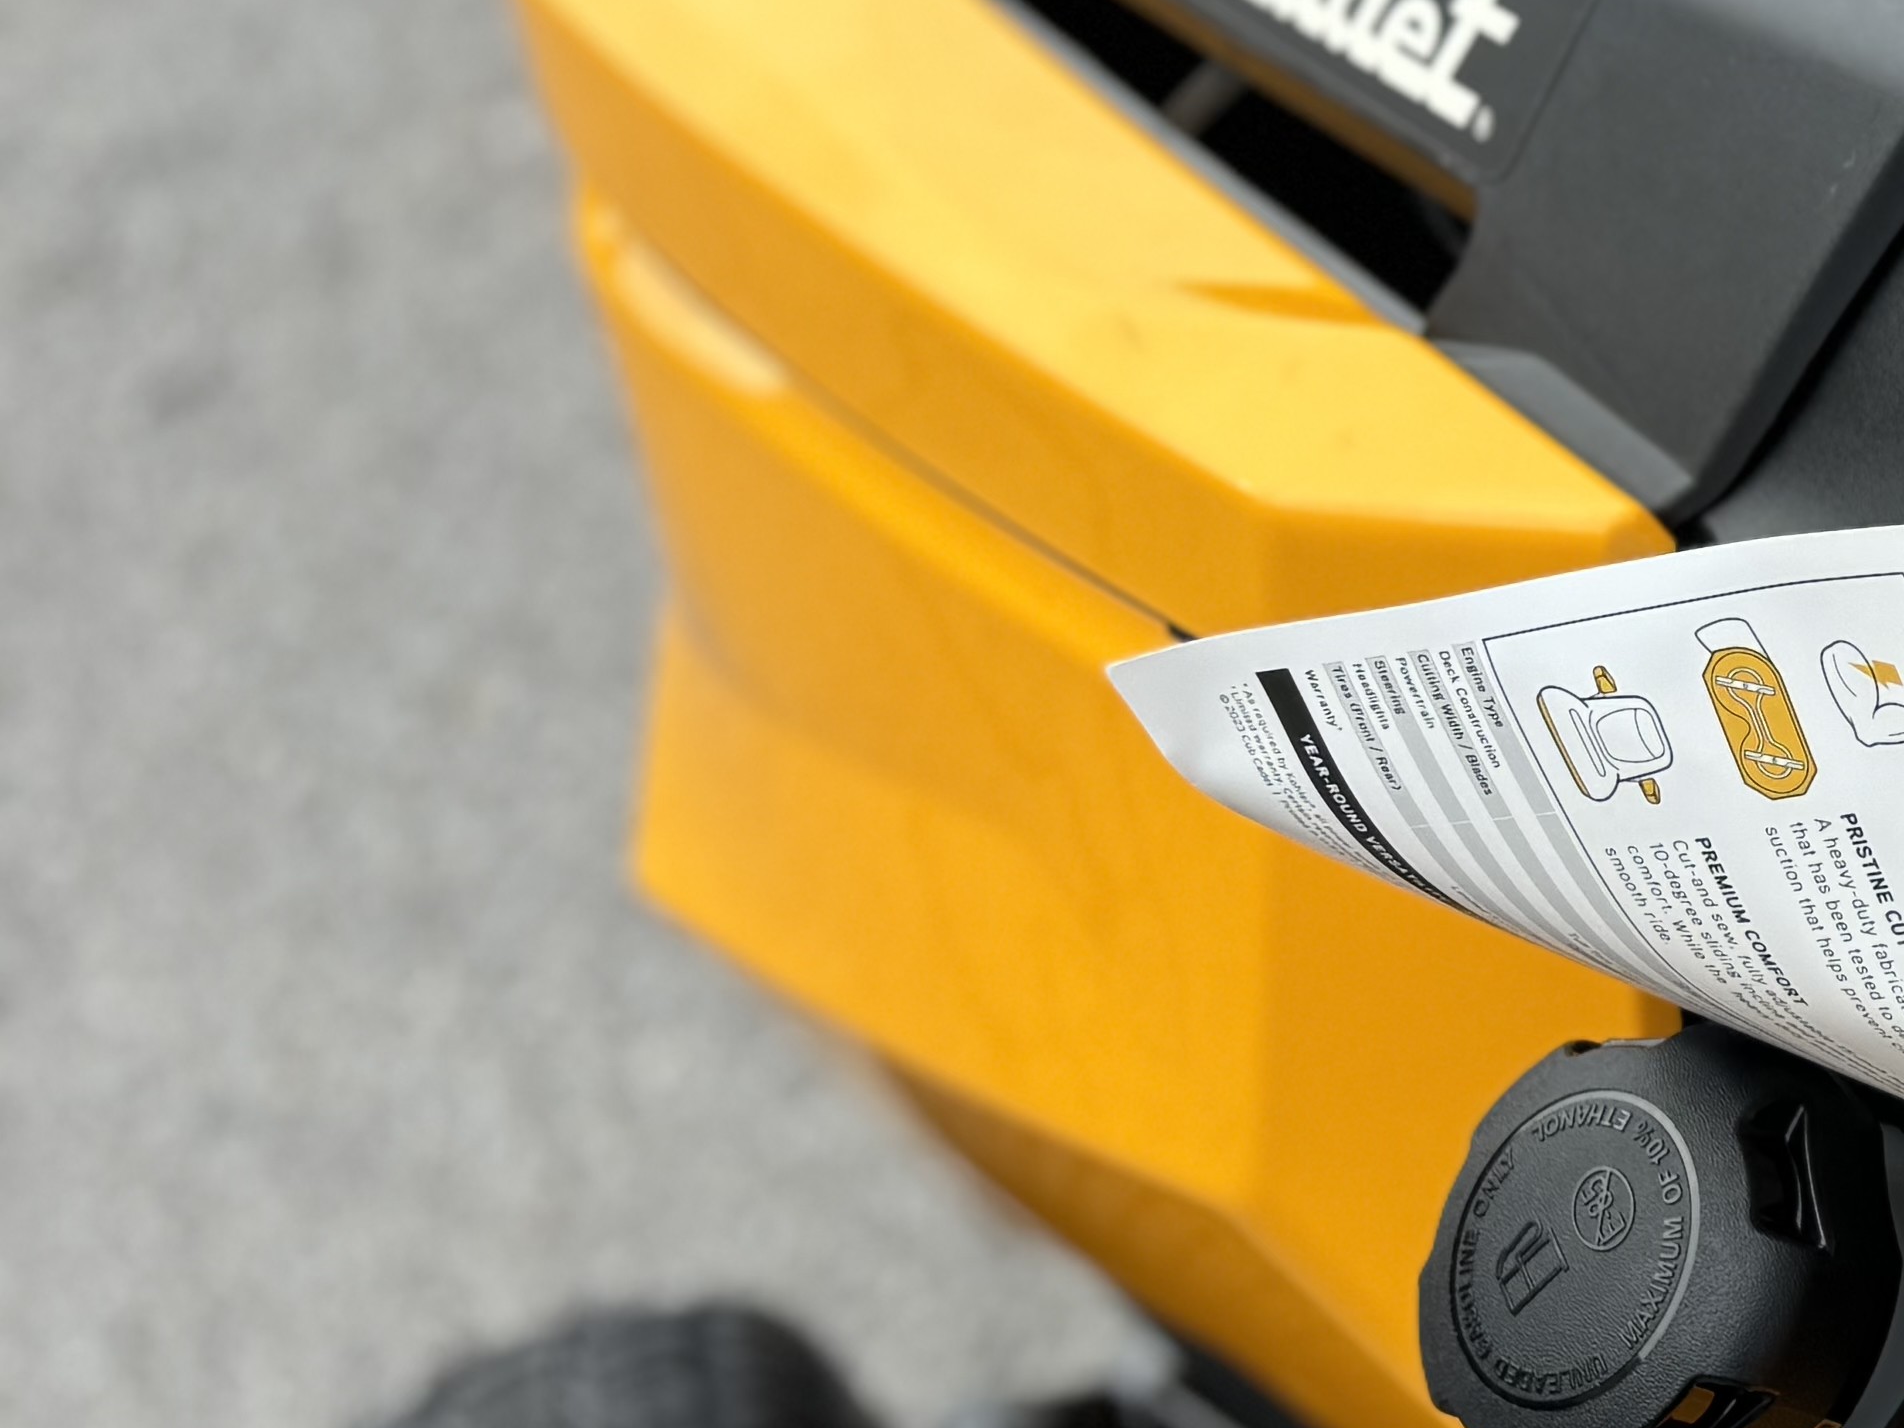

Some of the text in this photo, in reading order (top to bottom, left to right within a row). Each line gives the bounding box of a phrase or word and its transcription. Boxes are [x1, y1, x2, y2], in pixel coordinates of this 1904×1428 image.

[1332, 666, 1353, 699] Tires
[1376, 756, 1402, 791] Rear)
[1352, 663, 1390, 730] Headlights
[1374, 660, 1406, 715] Steering
[1395, 657, 1435, 729] Powertrain
[1417, 654, 1445, 701] Cutting
[1441, 704, 1464, 740] Width
[1465, 754, 1493, 796] Blades
[1439, 650, 1501, 768] Deck Construction
[1461, 647, 1504, 728] Engine Type
[1300, 733, 1368, 833] YEAR-ROUND
[1814, 817, 1832, 832] A
[1605, 847, 1648, 908] smooth
[1644, 911, 1671, 945] ride.
[1628, 845, 1727, 984] comfort. While the
[1649, 842, 1703, 926] 10-degree
[1700, 931, 1742, 979] sliding
[1672, 840, 1718, 908] Cut-and
[1737, 955, 1767, 985] fully
[1822, 836, 1878, 937] heavy-duty
[1840, 812, 1895, 904] PRISTINE
[1695, 837, 1751, 924] PREMIUM
[1744, 929, 1809, 1007] COMFORT
[1765, 826, 1892, 1039] suction that helps prevent
[1790, 822, 1816, 857] that
[1808, 862, 1831, 895] has
[1825, 899, 1853, 943] been
[1847, 948, 1883, 1002] tested
[1879, 1005, 1893, 1021] to
[1530, 1104, 1683, 1351] MAXIMUM OF 10% ETHANOL
